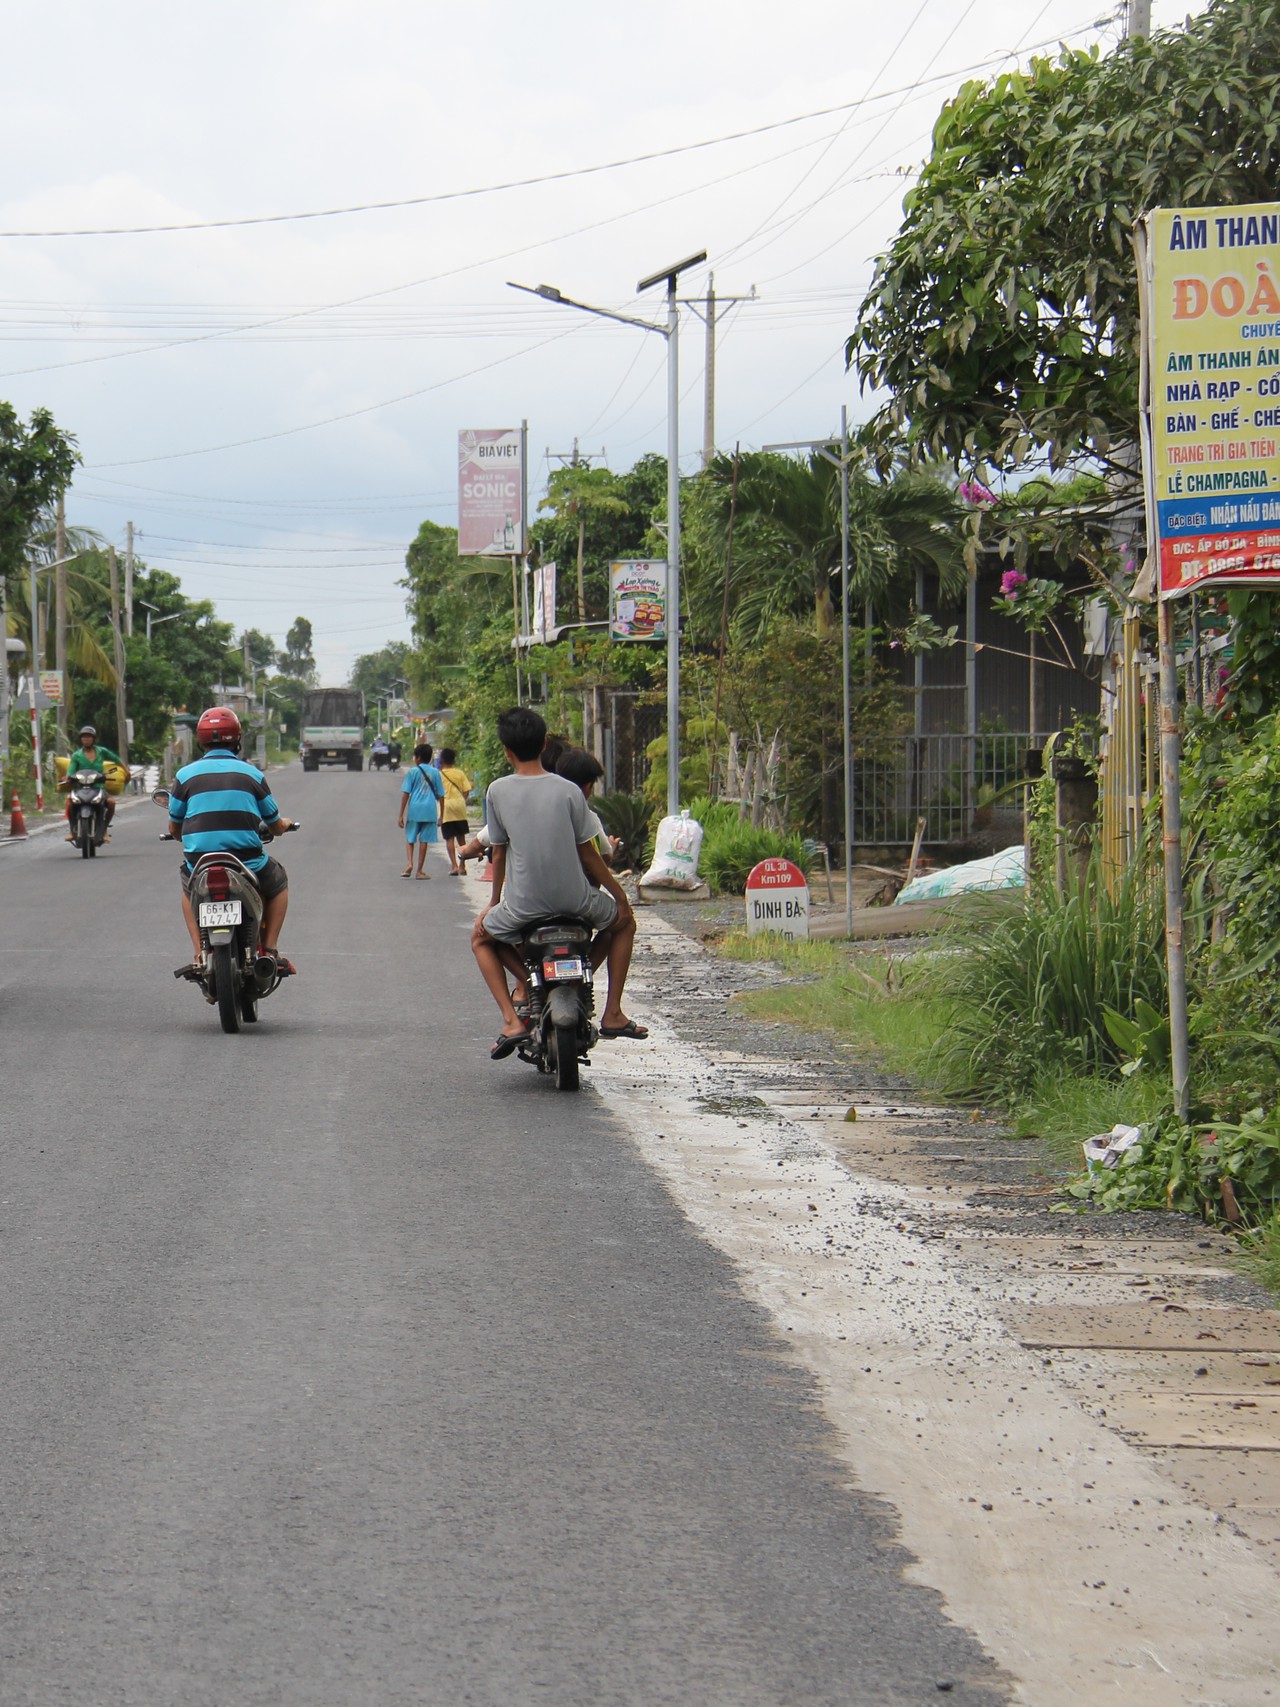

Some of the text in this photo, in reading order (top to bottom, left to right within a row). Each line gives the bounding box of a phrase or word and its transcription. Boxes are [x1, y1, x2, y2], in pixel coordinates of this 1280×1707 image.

[1169, 214, 1280, 251] ÂM THAN
[1172, 262, 1280, 320] ĐOÀ
[1167, 352, 1193, 372] ÂM
[1198, 350, 1251, 370] THANH
[1166, 380, 1202, 402] NHÀ
[1207, 381, 1240, 402] RẠP
[1166, 412, 1197, 433] BÀN
[1211, 406, 1240, 430] GHẾ
[479, 444, 518, 458] BIA VIỆT
[1167, 437, 1275, 464] TRANG TRÍ GIA TIÊN
[463, 482, 516, 498] SONIC
[1186, 470, 1268, 492] CHAMPAGNA
[1210, 501, 1238, 528] NHẬN
[1240, 497, 1260, 523] NẤU
[777, 862, 788, 872] 30
[206, 903, 234, 914] 66-K1
[786, 896, 801, 918] BÀ
